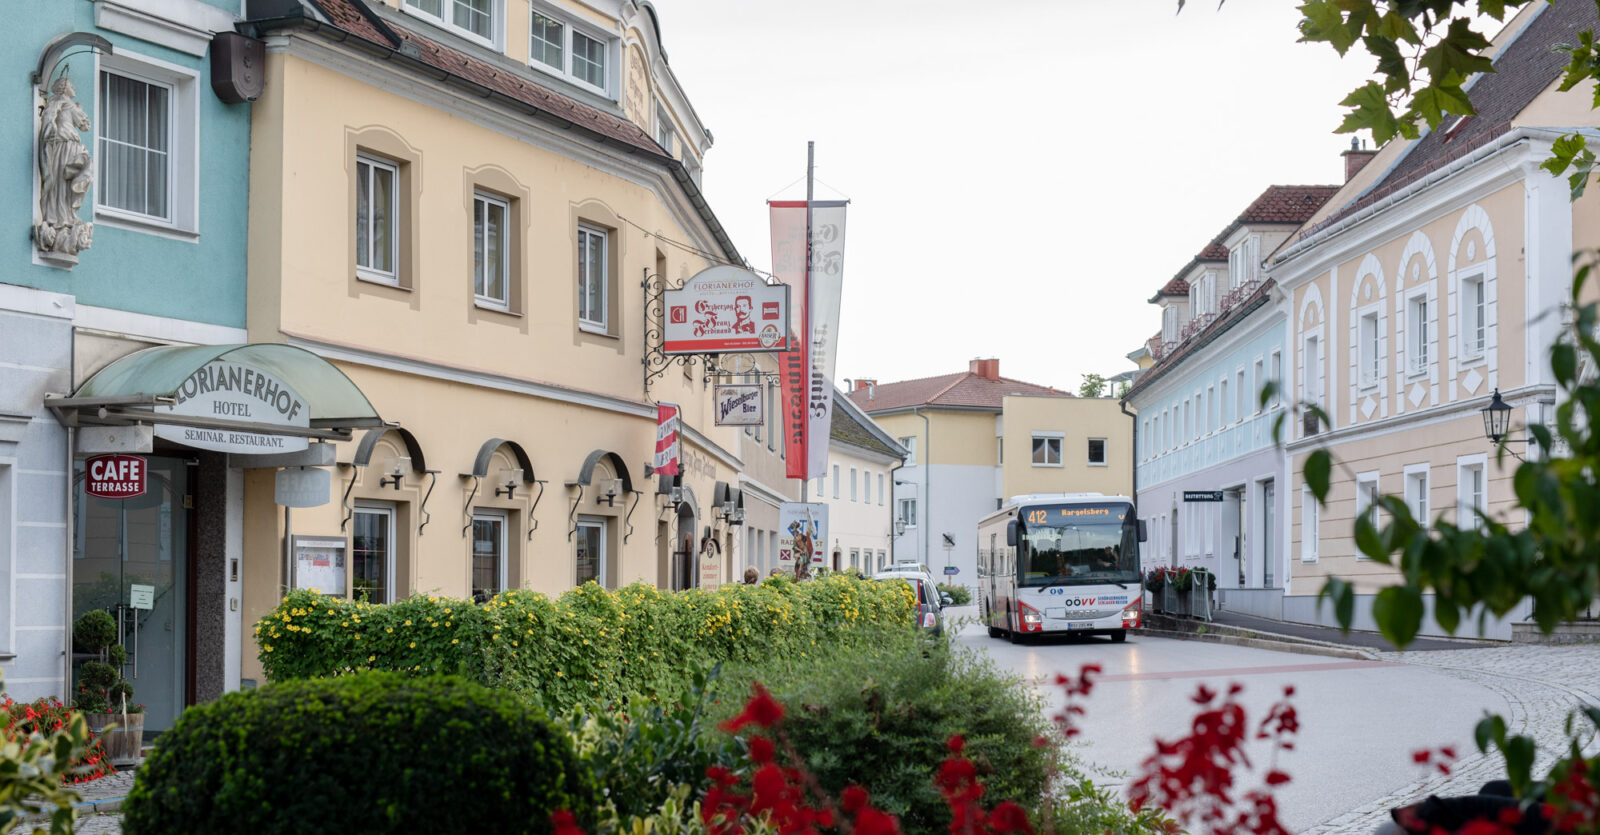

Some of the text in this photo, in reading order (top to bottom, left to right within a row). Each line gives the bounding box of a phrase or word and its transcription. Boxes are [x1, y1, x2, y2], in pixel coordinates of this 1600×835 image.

[169, 365, 302, 421] LORIANERHOF
[213, 400, 252, 417] HOTEL
[184, 429, 284, 448] SEMINAR. RESTAURANT.
[91, 460, 139, 481] CAFE
[91, 482, 139, 492] TERRASSE
[1028, 510, 1047, 524] 412
[1065, 596, 1096, 607] OÖVV
